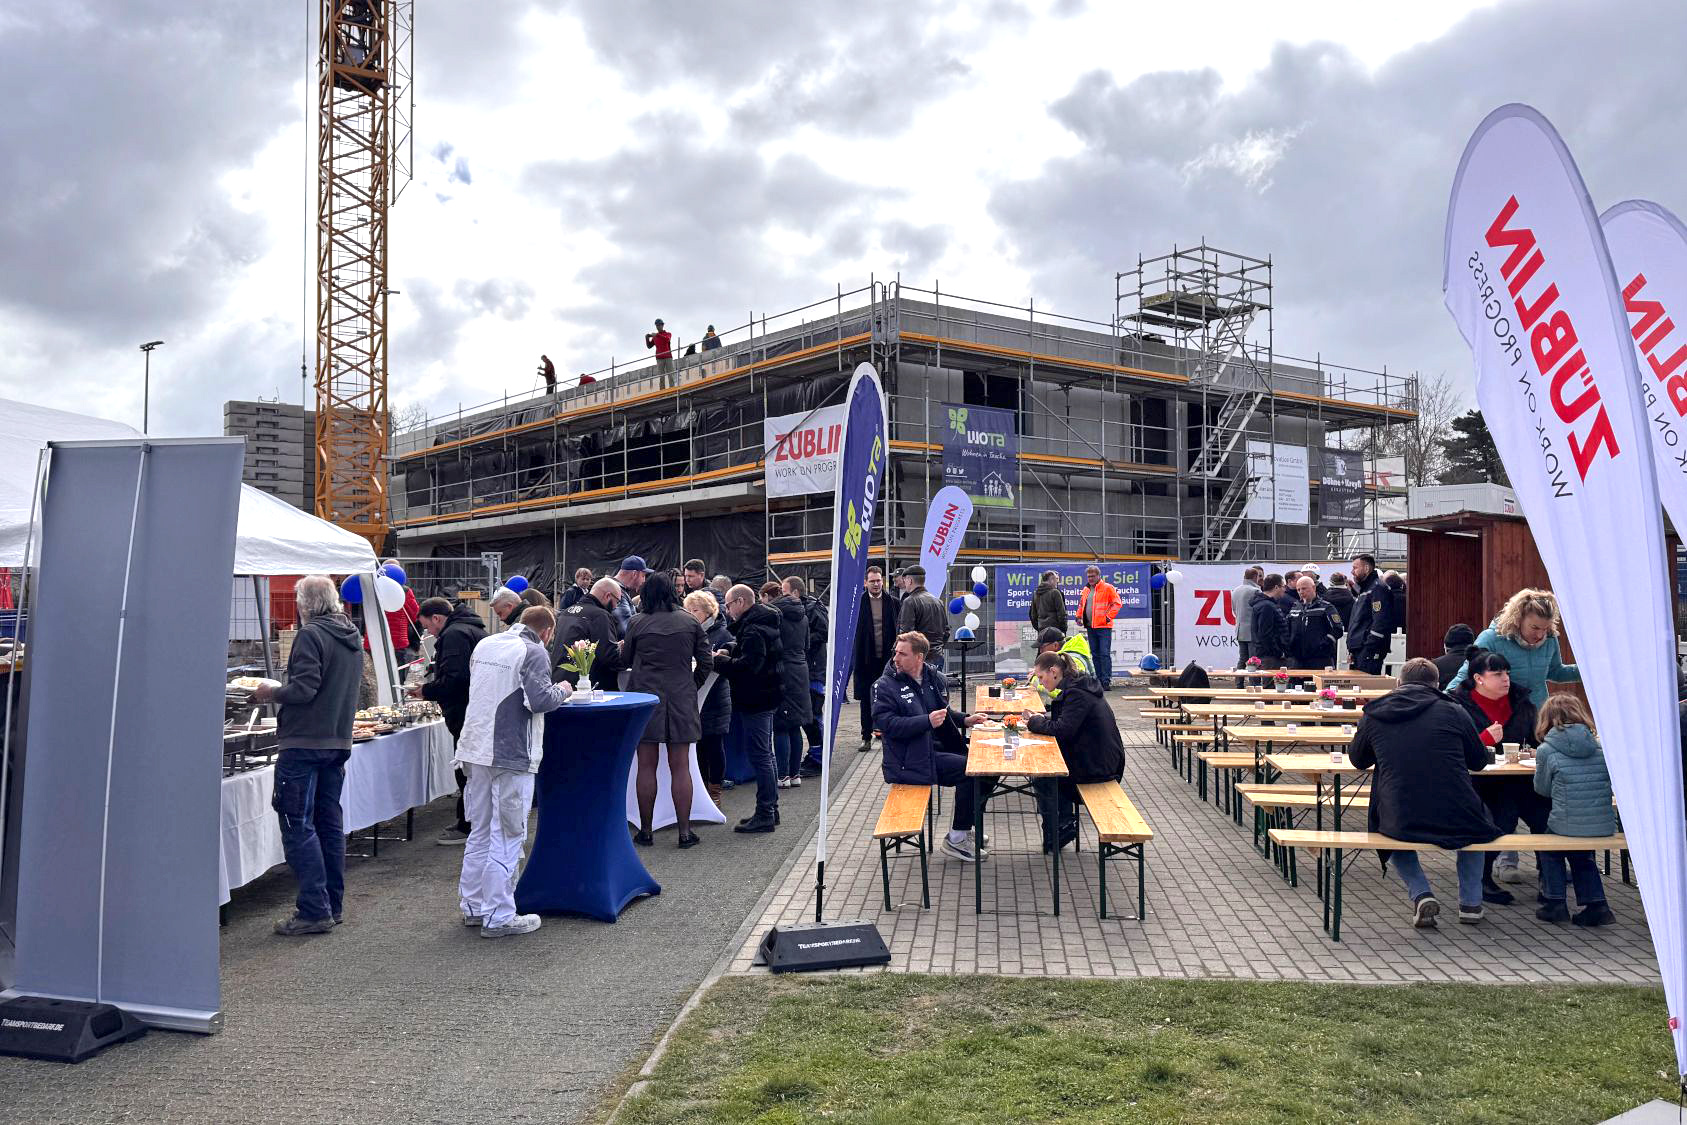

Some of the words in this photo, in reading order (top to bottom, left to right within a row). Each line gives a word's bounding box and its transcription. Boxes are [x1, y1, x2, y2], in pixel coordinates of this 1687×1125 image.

[775, 467, 798, 478] WORK
[800, 465, 812, 475] ON
[1007, 573, 1034, 586] Wir
[1113, 571, 1139, 584] Sie!
[1007, 588, 1032, 598] Sport-
[1196, 635, 1238, 647] WORK
